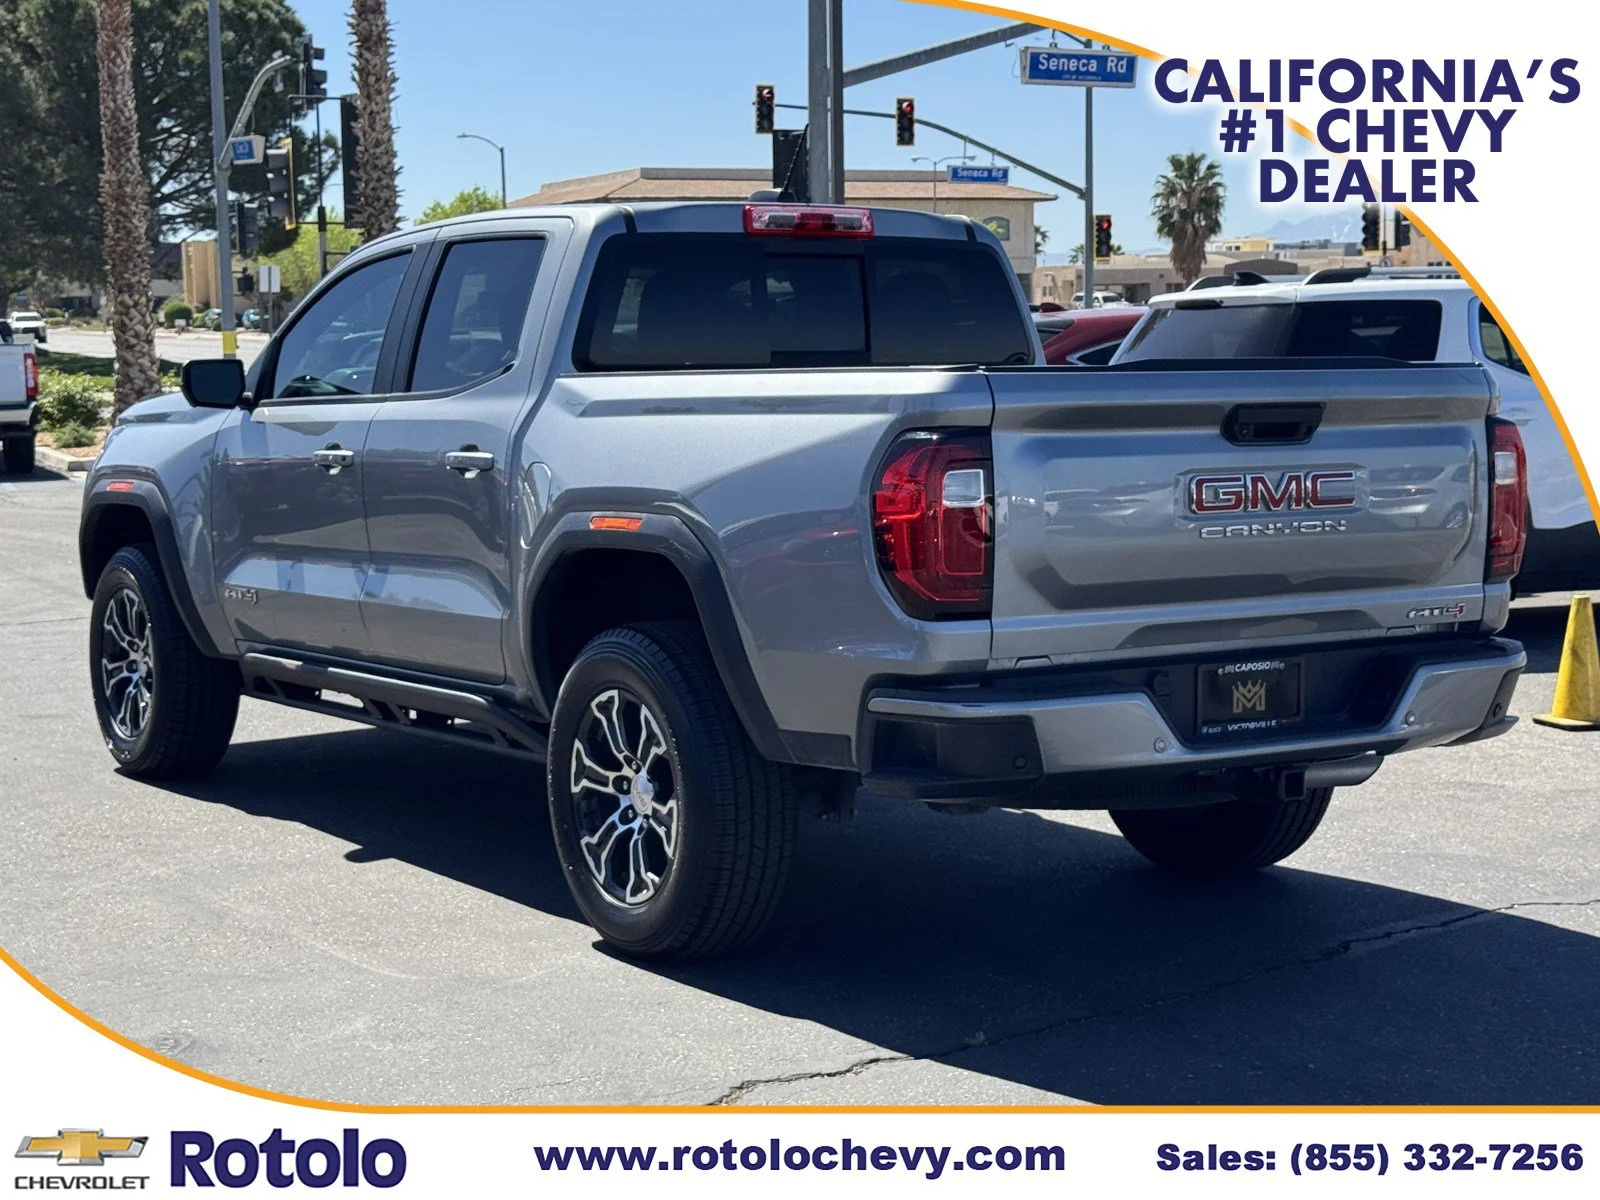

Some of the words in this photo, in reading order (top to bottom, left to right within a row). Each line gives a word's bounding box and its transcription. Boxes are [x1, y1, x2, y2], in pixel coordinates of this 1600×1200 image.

[1038, 54, 1098, 72] Seneca
[1106, 57, 1127, 73] Rd
[957, 168, 988, 178] Seneca
[991, 168, 1004, 178] Rd
[1190, 470, 1356, 514] GMC
[1200, 520, 1347, 539] CANYON
[1407, 603, 1467, 619] AT4
[1235, 661, 1271, 672] CAPOSIO
